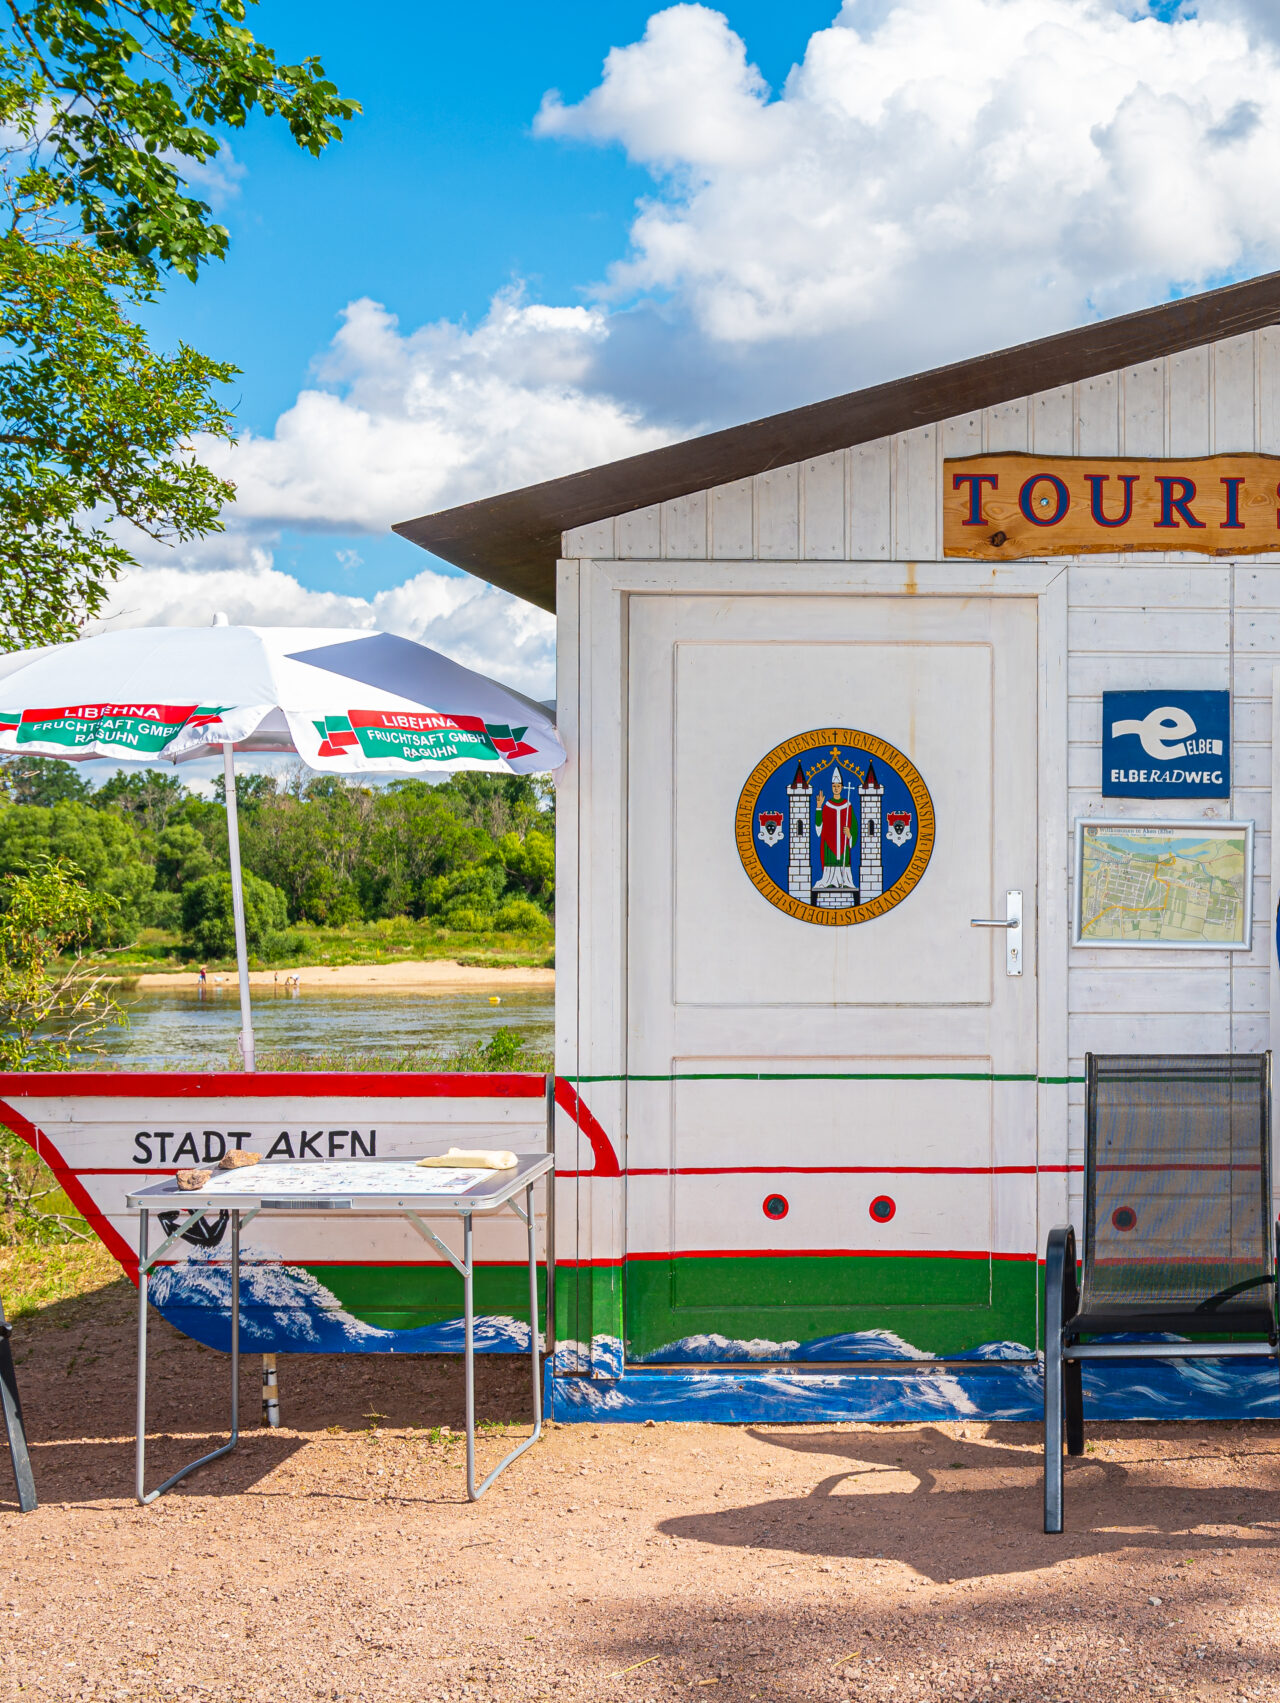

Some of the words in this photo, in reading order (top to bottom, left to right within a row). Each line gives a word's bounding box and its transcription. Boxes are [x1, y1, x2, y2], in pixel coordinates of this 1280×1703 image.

[64, 705, 161, 720] LIBEHNA
[382, 714, 460, 729] LIBEHNA
[74, 728, 140, 746] RAGUHN
[138, 722, 182, 738] GMBH
[366, 729, 445, 746] FRUCHTSAFT
[448, 732, 487, 744] GMBH
[403, 744, 458, 759] RAGUHN
[841, 730, 899, 764] SIGNETVM
[1186, 738, 1213, 756] ELBE
[746, 730, 828, 801] MAGDEBVRGENSIS
[1110, 768, 1224, 785] ELBERADWEG
[739, 804, 757, 868] ECCLESIAE
[907, 846, 929, 885] VRBIS
[750, 870, 783, 906] FILIAE
[785, 898, 838, 925] FIDELIS
[132, 1130, 252, 1164] STADT
